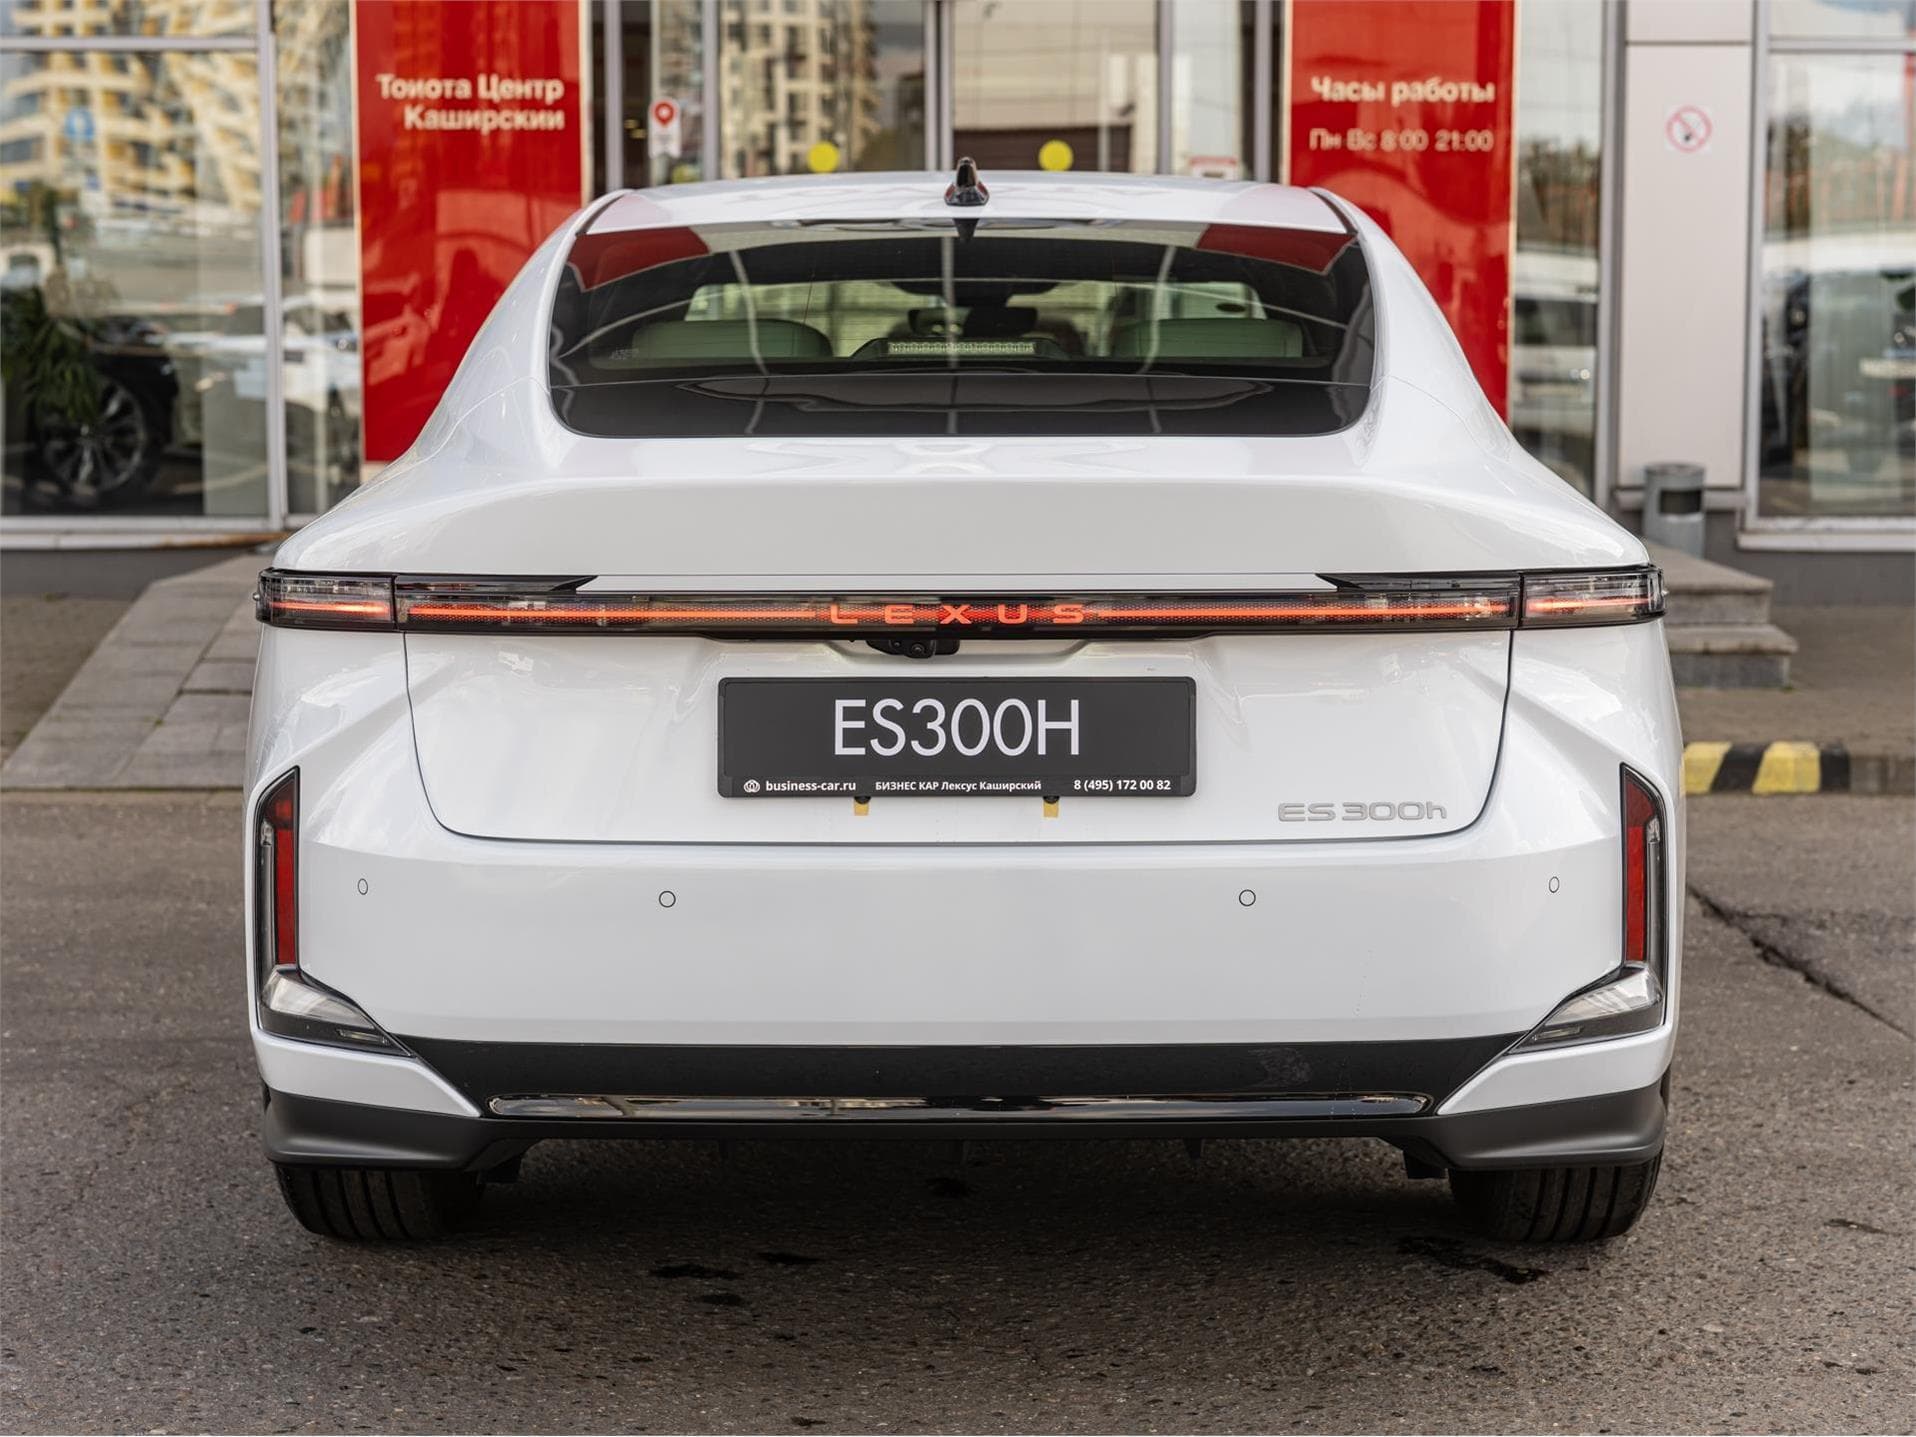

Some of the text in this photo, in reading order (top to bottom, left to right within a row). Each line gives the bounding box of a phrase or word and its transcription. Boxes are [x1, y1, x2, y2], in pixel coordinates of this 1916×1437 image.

[477, 73, 565, 105] Центр
[1311, 76, 1496, 107] Часы работы
[1434, 128, 1494, 152] 21:00
[830, 604, 1084, 624] LEXUS
[833, 698, 1080, 757] ES300H
[765, 780, 857, 792] business-car.ru
[875, 780, 1042, 793] БИЗНЕС КАР Лексус Каширский
[1073, 779, 1172, 793] 8 (495) 172 00 82
[1278, 801, 1447, 822] ES 300h
